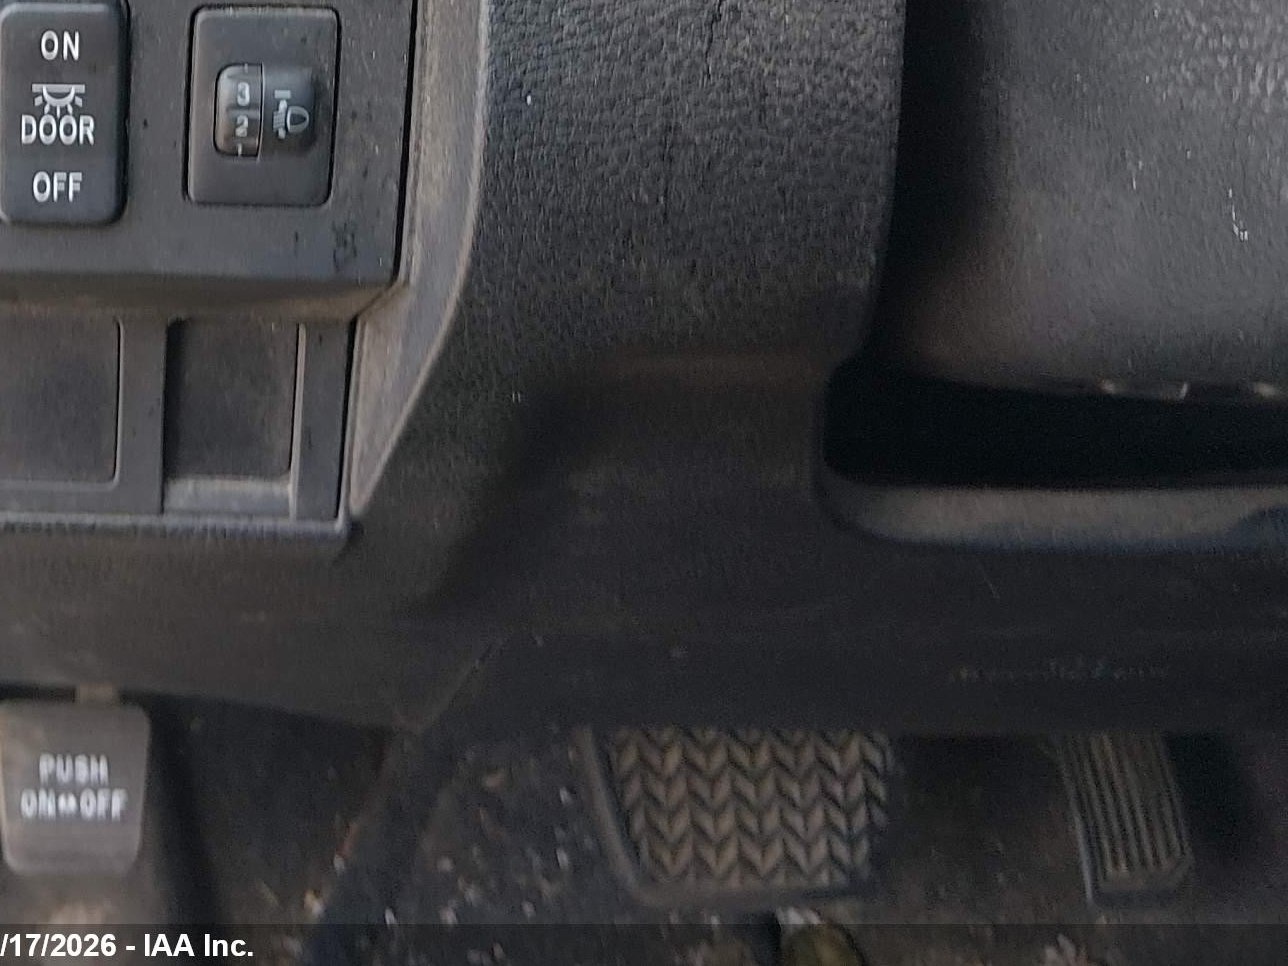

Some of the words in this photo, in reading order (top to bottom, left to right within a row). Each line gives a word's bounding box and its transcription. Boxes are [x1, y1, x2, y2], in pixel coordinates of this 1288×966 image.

[40, 30, 80, 61] ON
[236, 81, 251, 107] 3
[21, 114, 95, 146] DOOR
[235, 114, 250, 138] 2
[32, 171, 83, 203] OFF
[39, 753, 109, 785] PUSH
